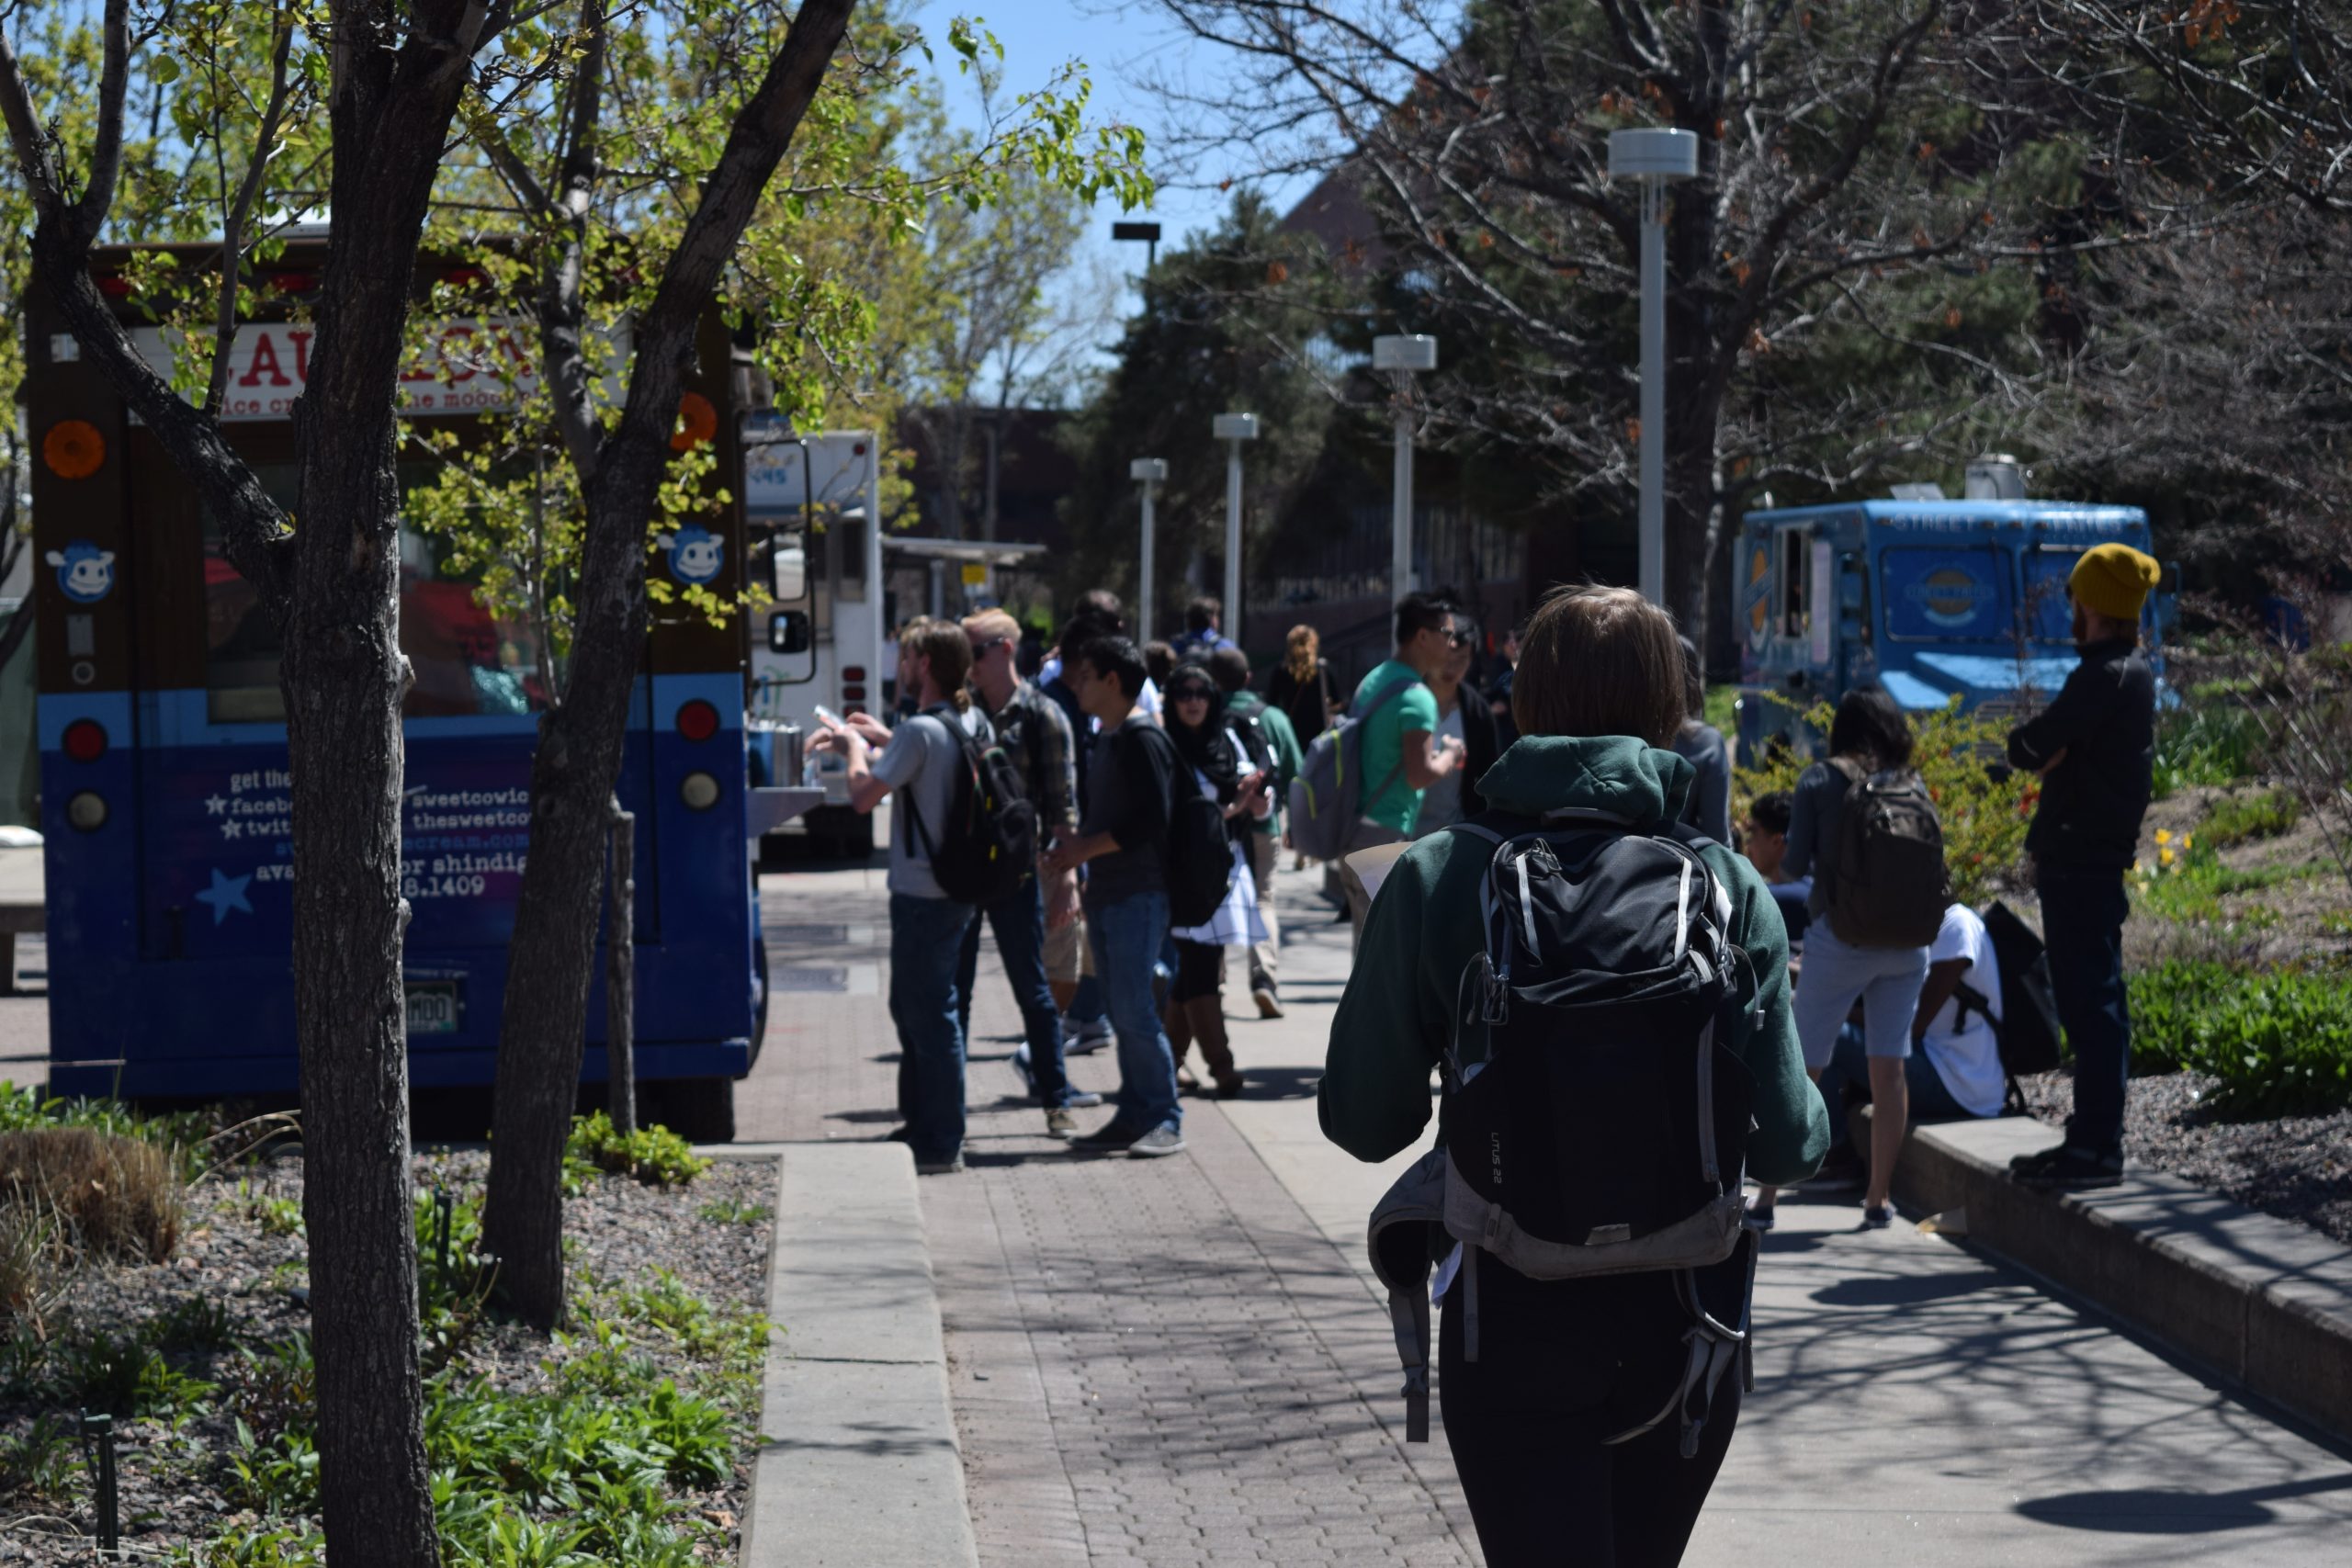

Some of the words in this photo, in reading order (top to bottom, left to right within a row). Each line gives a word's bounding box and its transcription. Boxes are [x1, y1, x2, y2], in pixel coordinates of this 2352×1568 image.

[223, 397, 260, 415] ice
[231, 770, 260, 794] get
[265, 769, 292, 788] the
[231, 796, 293, 815] faceb
[413, 787, 530, 808] sweetcowic
[246, 818, 293, 837] twit
[413, 810, 532, 829] thesweetco
[433, 852, 527, 876] shindig
[1491, 1132, 1500, 1165] LITUS
[1493, 1168, 1502, 1184] 22
